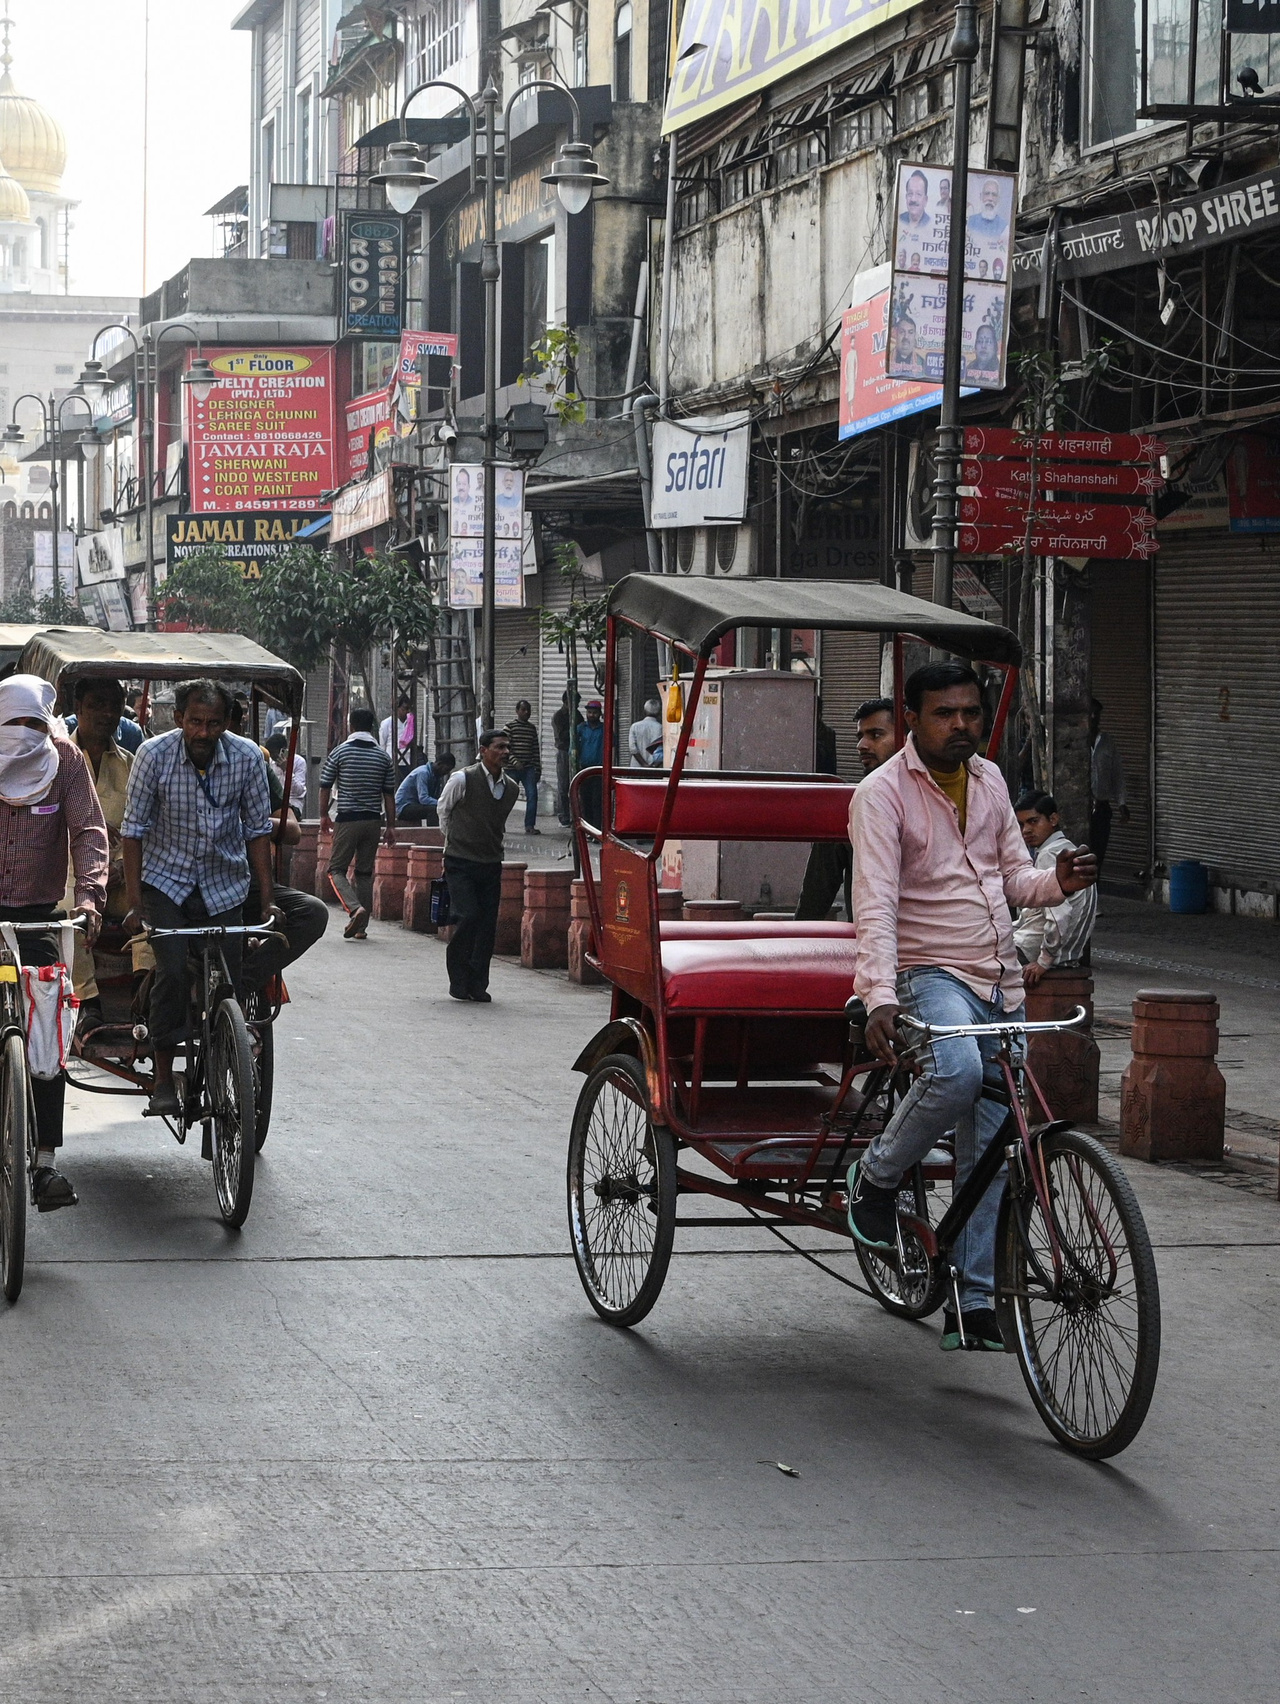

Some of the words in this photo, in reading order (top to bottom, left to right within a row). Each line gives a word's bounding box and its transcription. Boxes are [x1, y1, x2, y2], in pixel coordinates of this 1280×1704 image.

[1202, 179, 1279, 235] SHREE
[359, 225, 390, 237] 1862
[1061, 229, 1125, 261] outure
[348, 238, 369, 313] ROOP
[377, 240, 399, 314] SAREE
[347, 314, 398, 326] CREATION
[249, 360, 294, 371] FLOOR
[259, 376, 325, 388] CREATION
[231, 390, 259, 399] (PVT.)
[263, 389, 292, 398] (LTD.)
[208, 400, 275, 409] DESIGNER
[208, 411, 263, 420] LEHNGA
[266, 410, 317, 419] CHUNNI
[209, 422, 252, 431] SAREE
[256, 422, 286, 430] SUIT
[202, 433, 243, 441] Contact
[253, 431, 322, 440] 9810668426
[199, 443, 267, 460] JAMAI
[272, 443, 326, 459] RAJA
[1058, 437, 1112, 454] शहनशाही
[214, 459, 287, 469] SHERWANI
[665, 431, 728, 493] safari
[214, 472, 248, 482] INDO
[252, 471, 318, 482] WESTERN
[1010, 469, 1041, 483] Kata
[1044, 471, 1119, 485] Shahanshahi
[214, 485, 249, 495] COAT
[254, 485, 293, 495] PAINT
[235, 500, 319, 509] 845911289
[172, 519, 245, 544] JAMAI
[223, 543, 276, 558] CREATIONS
